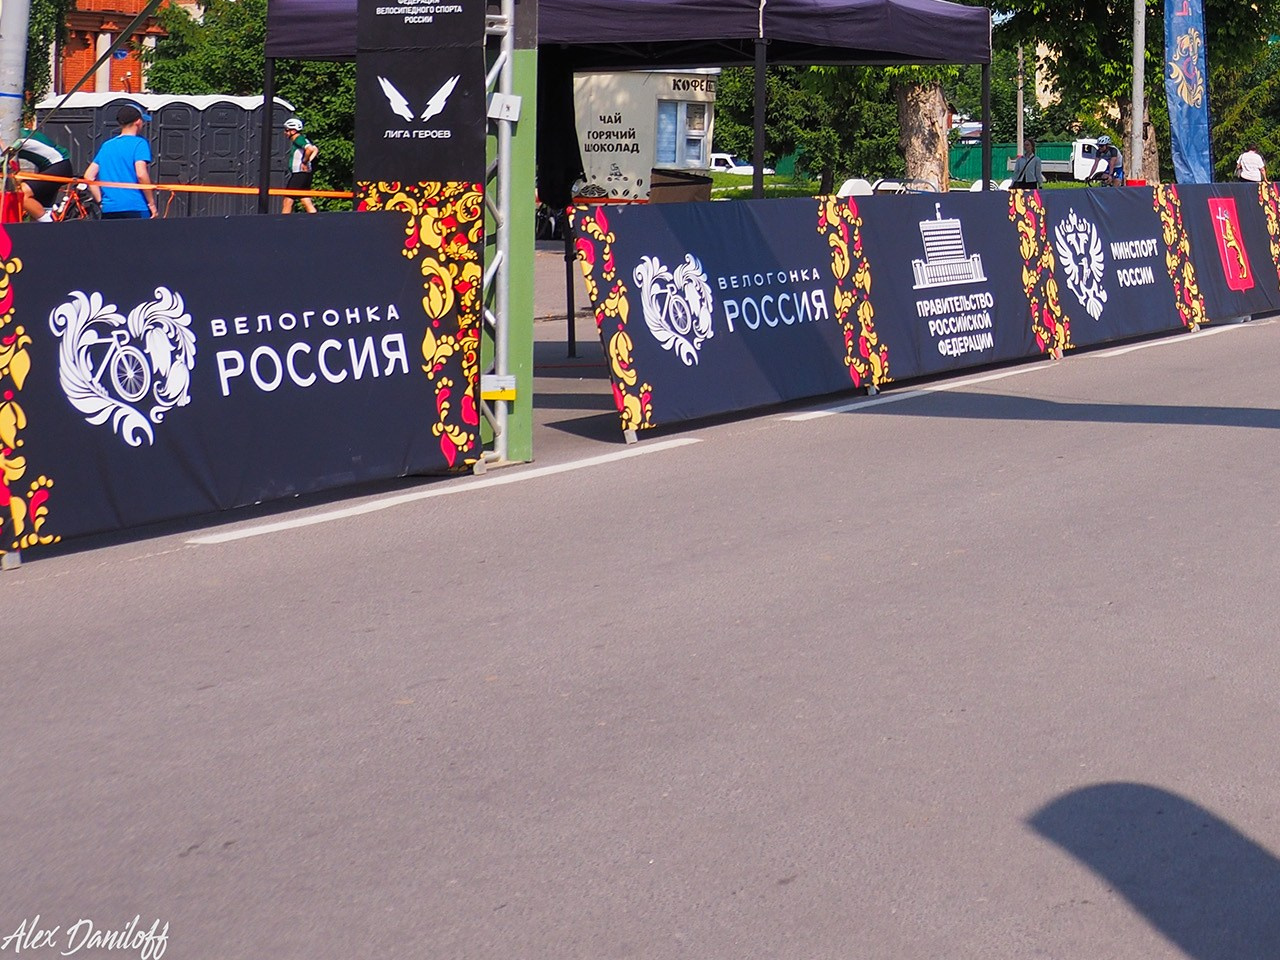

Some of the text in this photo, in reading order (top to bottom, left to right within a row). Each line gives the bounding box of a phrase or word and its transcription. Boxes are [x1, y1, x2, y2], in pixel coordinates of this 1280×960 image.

[376, 5, 462, 16] ВЕЛОСИПЕДНОГО СПОРТА
[404, 15, 433, 25] РОССИИ
[672, 78, 705, 92] КОФЕ
[599, 112, 622, 125] ЧАЙ
[383, 129, 451, 139] ЛИГА ГЕРОЕВ
[587, 127, 636, 140] ГОРЯЧИЙ
[584, 142, 640, 155] ШОКОЛАД
[1110, 237, 1160, 262] МИНСПОРТ
[717, 265, 821, 291] ВЕЛОГОНКА
[1116, 265, 1155, 289] РОССИИ
[722, 288, 830, 333] РОССИЯ
[915, 291, 995, 319] ПРАВИТЕЛЬСТВО
[210, 303, 400, 337] ВЕЛОГОНКА
[928, 309, 992, 336] РОССИЙСКОЙ
[937, 332, 994, 359] ФЕДЕРАЦИИ
[215, 332, 410, 397] РОССИЯ
